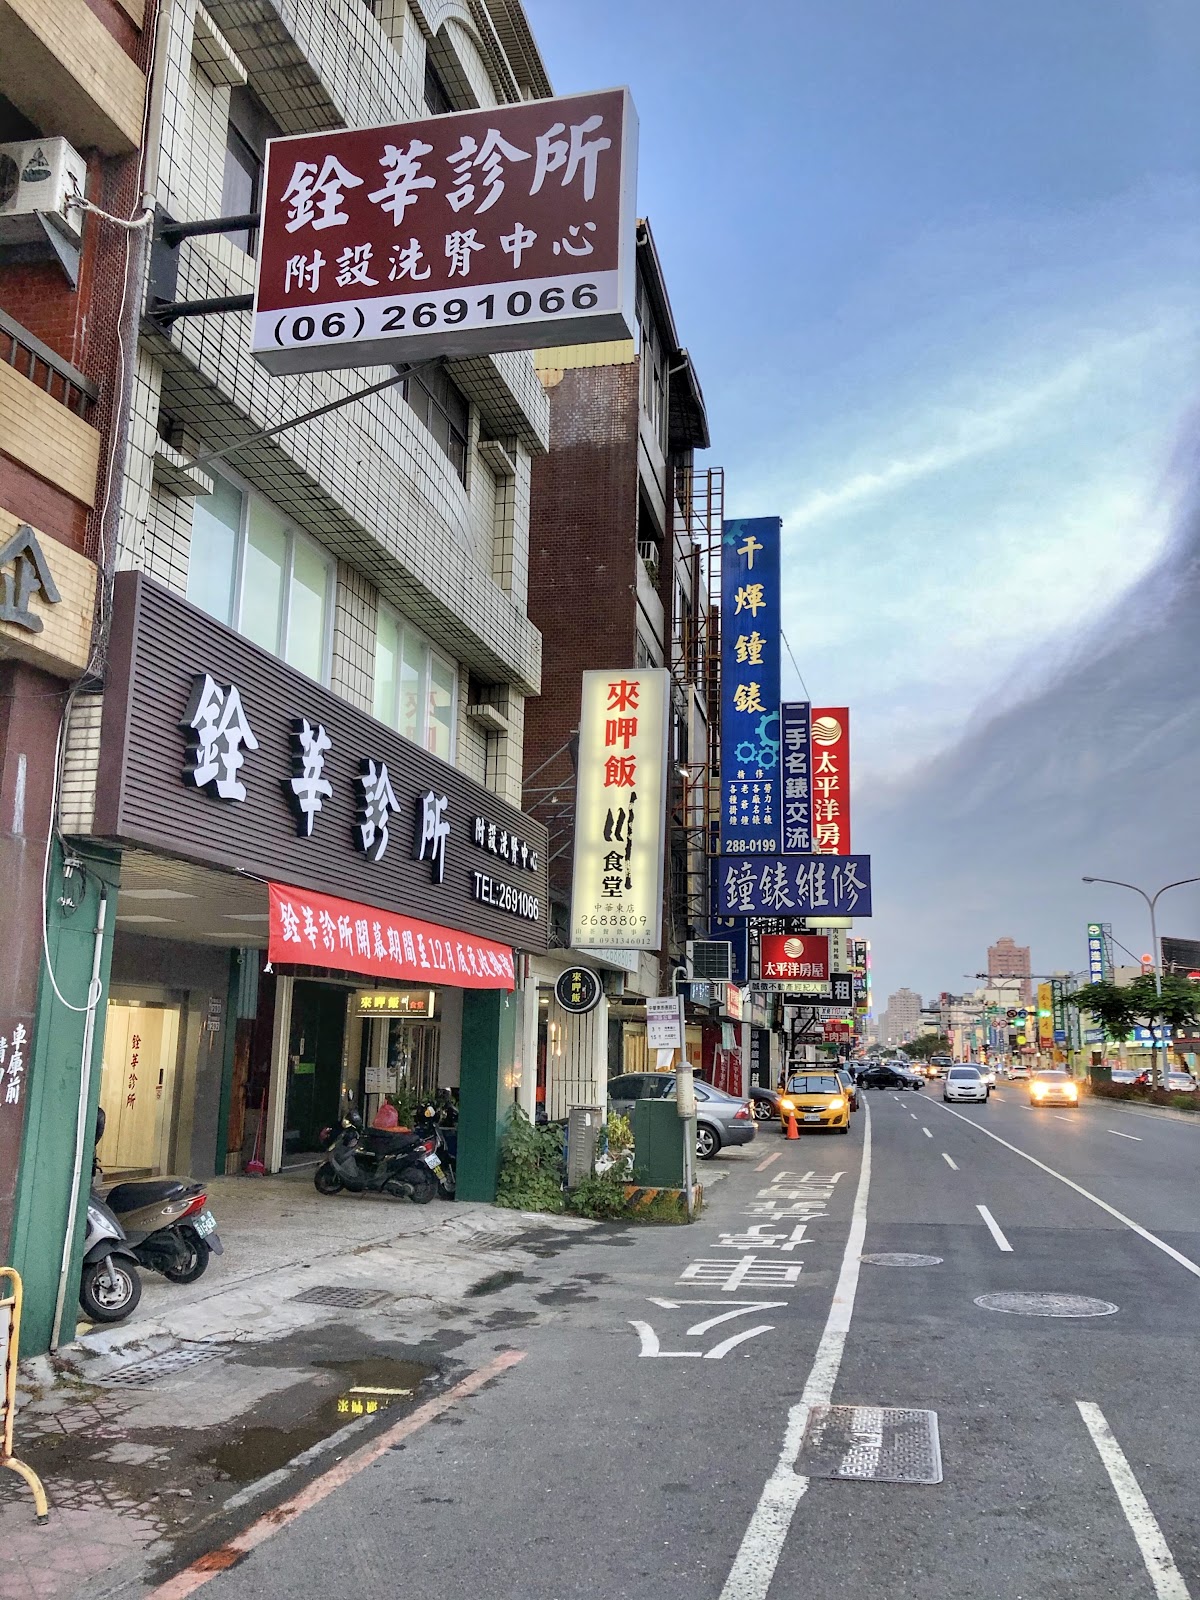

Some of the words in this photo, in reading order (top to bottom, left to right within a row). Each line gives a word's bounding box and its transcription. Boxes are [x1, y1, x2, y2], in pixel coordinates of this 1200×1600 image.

[281, 115, 612, 234] 銓華診所
[284, 221, 597, 294] 附設洗腎中心
[603, 680, 640, 788] 來呷飯
[181, 673, 450, 884] 銓華診所
[784, 703, 810, 850] 二手名錶交流
[475, 817, 538, 871] 附設洗腎中心
[726, 839, 776, 853] 288-0199
[594, 903, 635, 914] 中華東店
[724, 861, 867, 912] 鐘錶維修
[581, 915, 647, 926] 2688809
[600, 937, 651, 945] 0931346012
[571, 972, 581, 1002] 來呷飯
[752, 982, 828, 992] 誠徵不動產經紀人員
[765, 962, 825, 978] 太平洋房屋
[361, 996, 399, 1009] 來呷飯
[6, 1023, 27, 1105] 車庫前
[126, 1034, 142, 1110] 銓華診所
